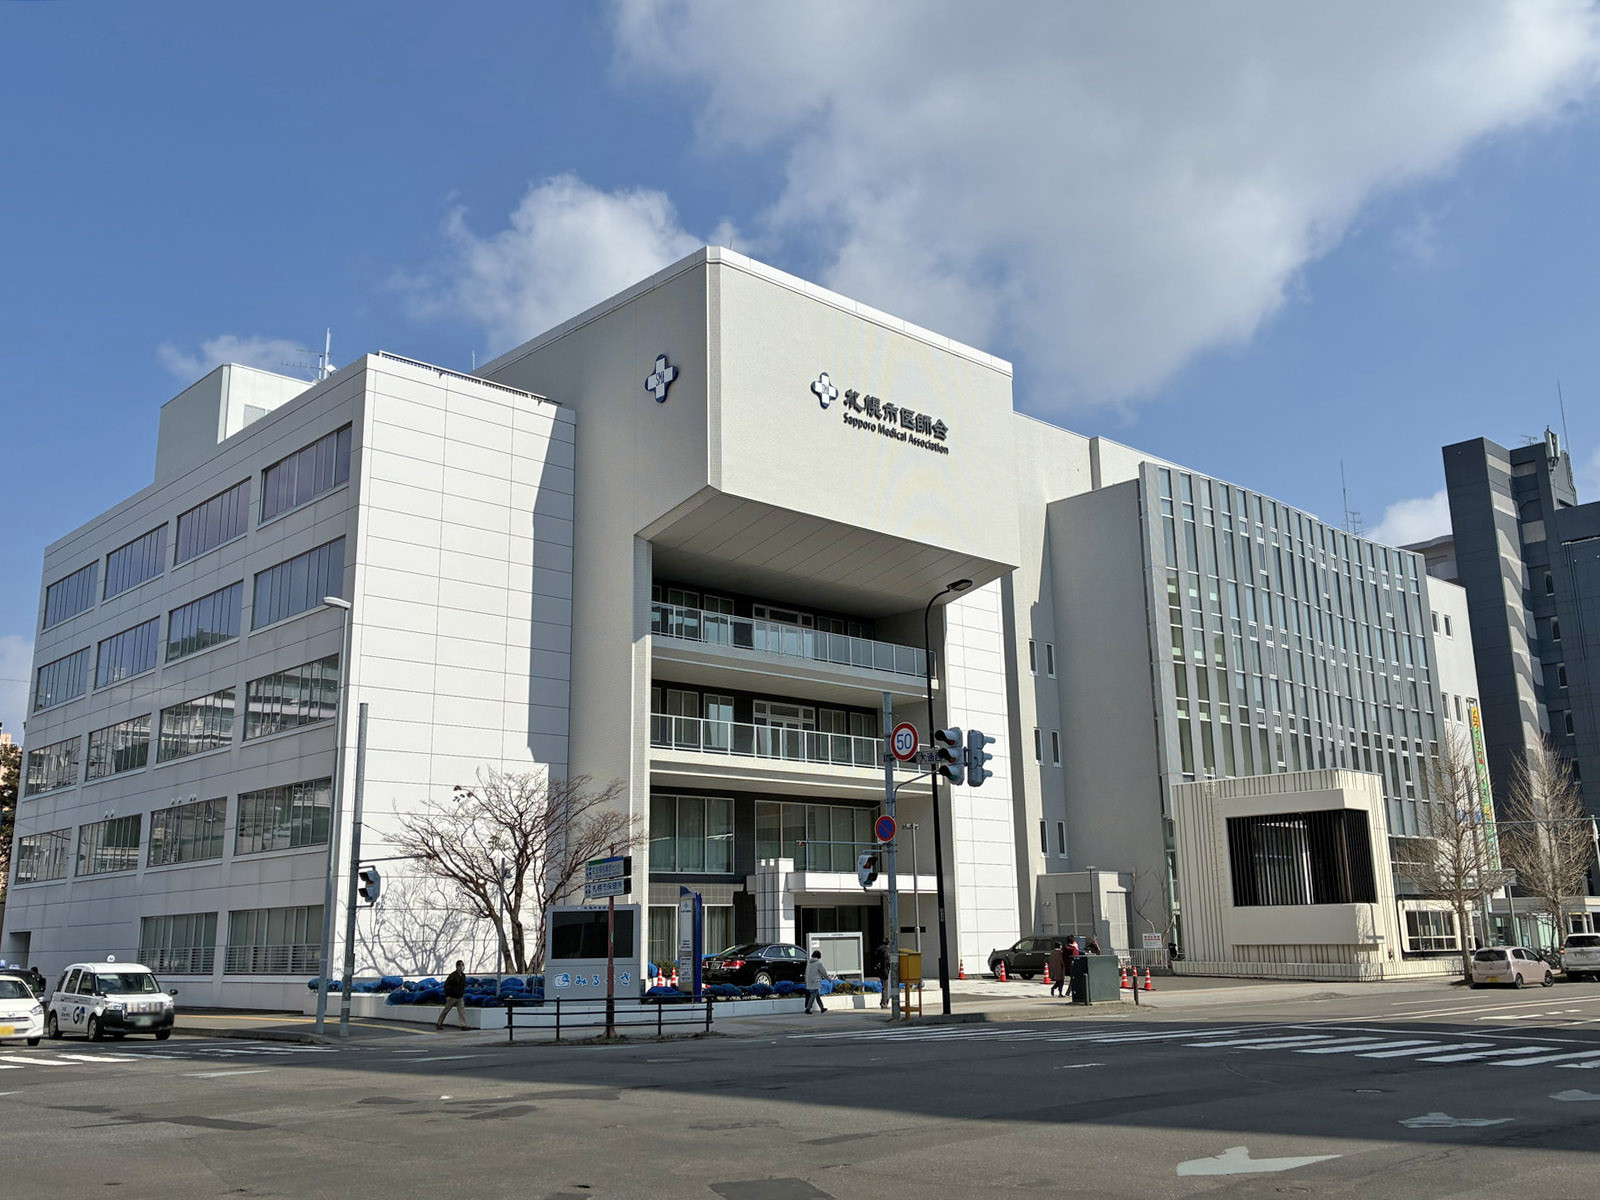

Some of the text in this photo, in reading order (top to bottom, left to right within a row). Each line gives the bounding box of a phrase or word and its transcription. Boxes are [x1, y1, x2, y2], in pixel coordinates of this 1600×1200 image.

[843, 388, 949, 440] 札幌市医師会
[843, 412, 949, 455] Sapporo Medical Association
[896, 733, 913, 750] 50
[576, 971, 630, 986] みるさ
